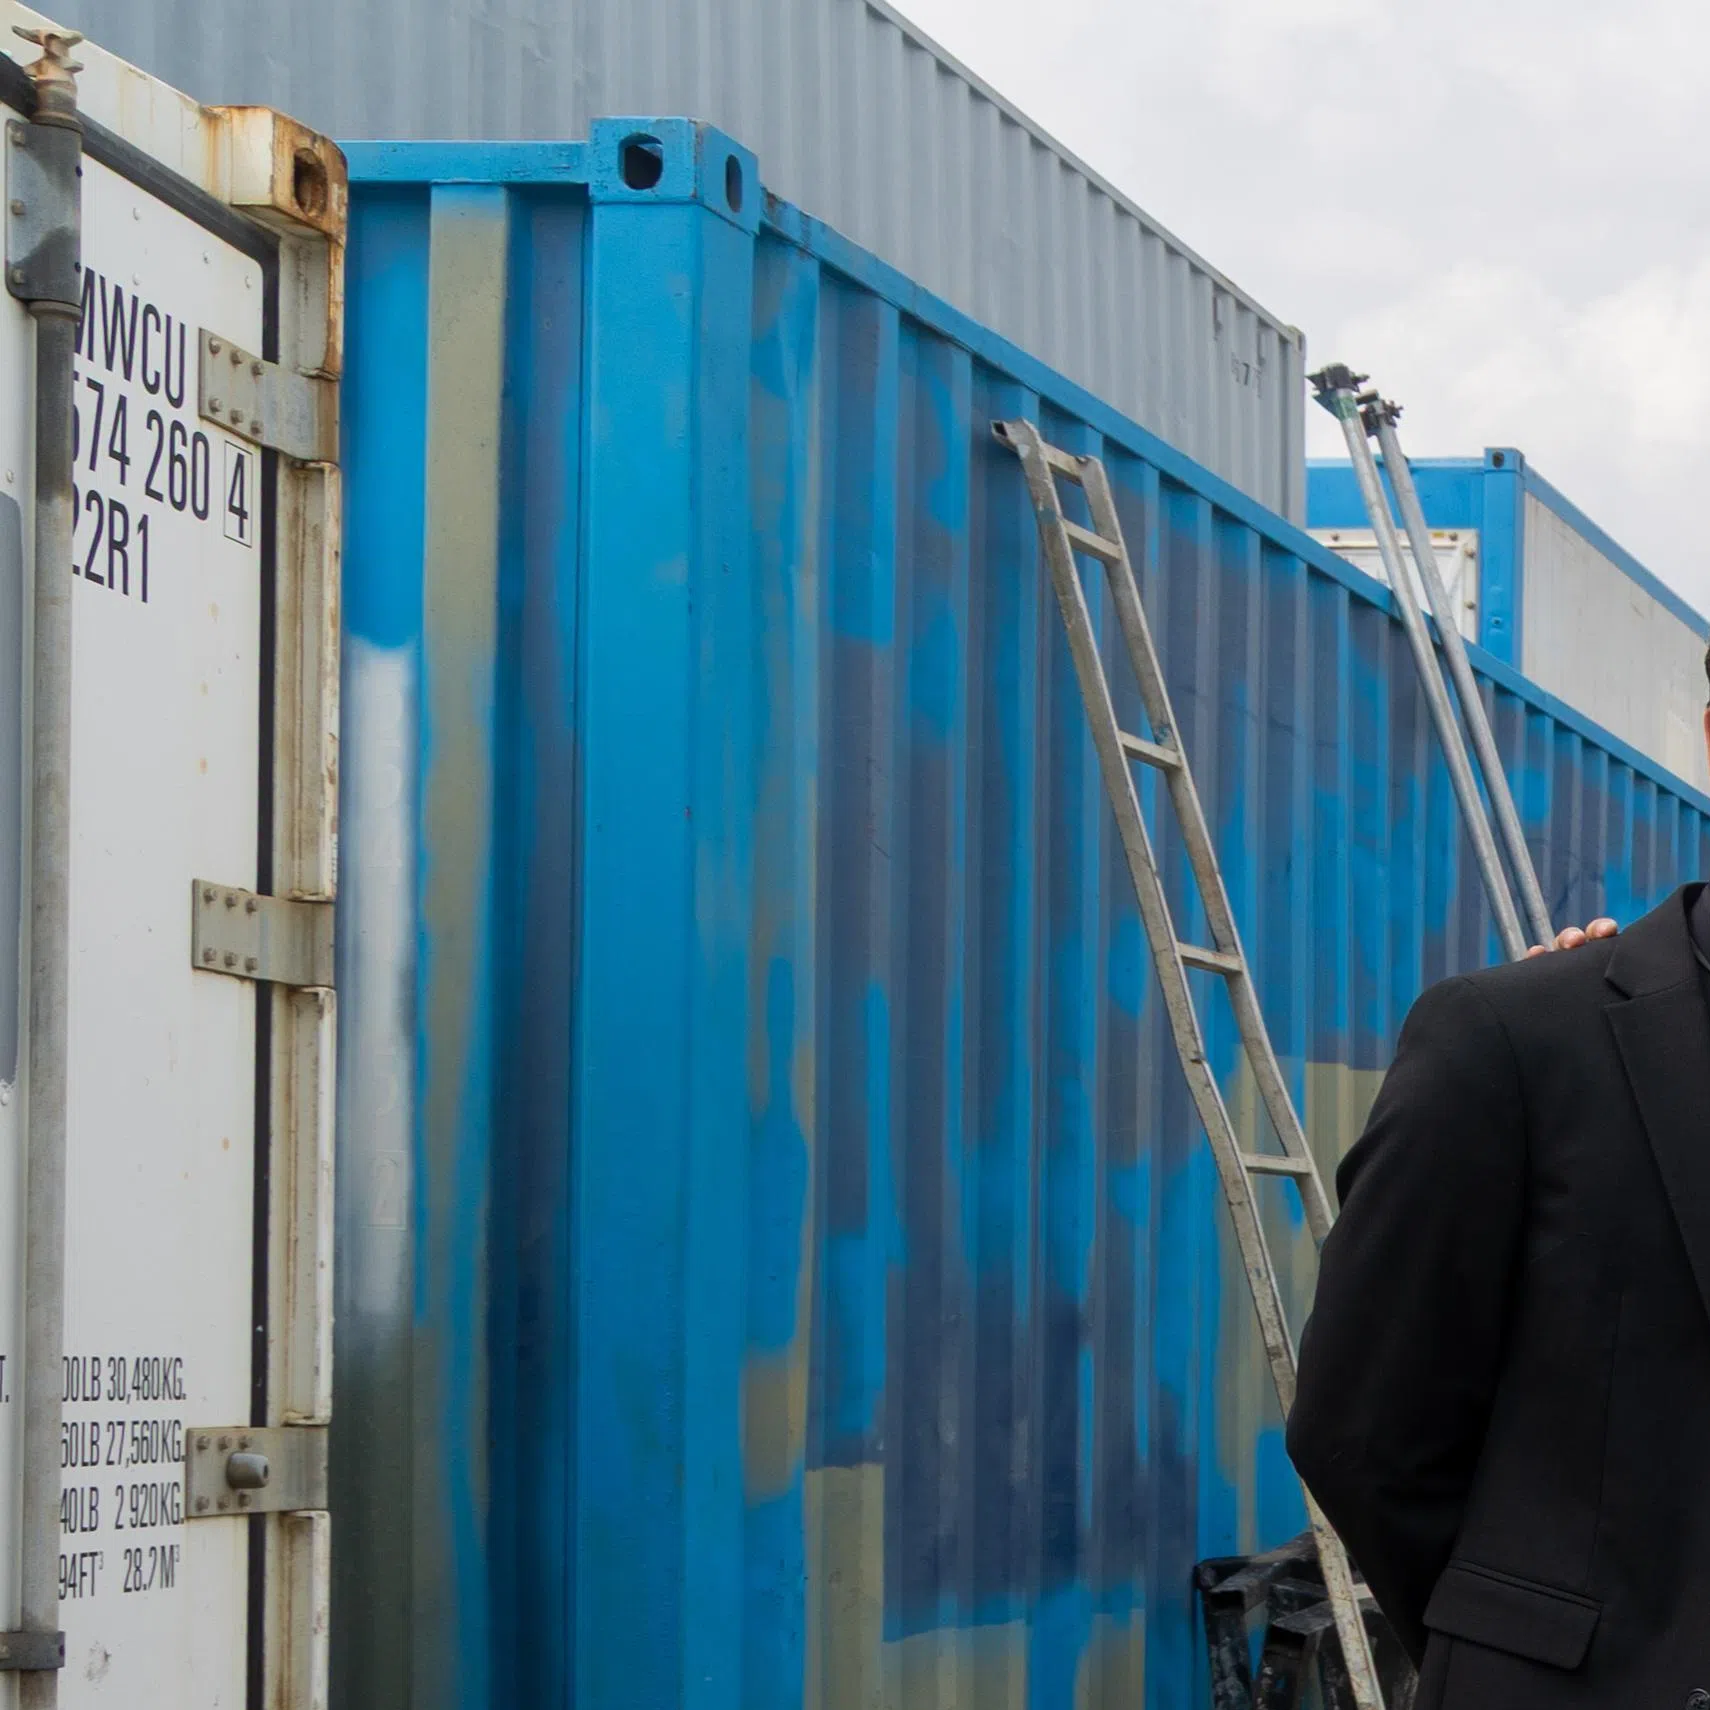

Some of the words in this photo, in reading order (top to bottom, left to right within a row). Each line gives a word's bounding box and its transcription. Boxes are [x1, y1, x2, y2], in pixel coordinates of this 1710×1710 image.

[145, 410, 211, 522] 260
[228, 452, 249, 541] 4
[107, 1356, 187, 1404] 30,480KG.
[105, 1420, 185, 1468] 27,560KG.
